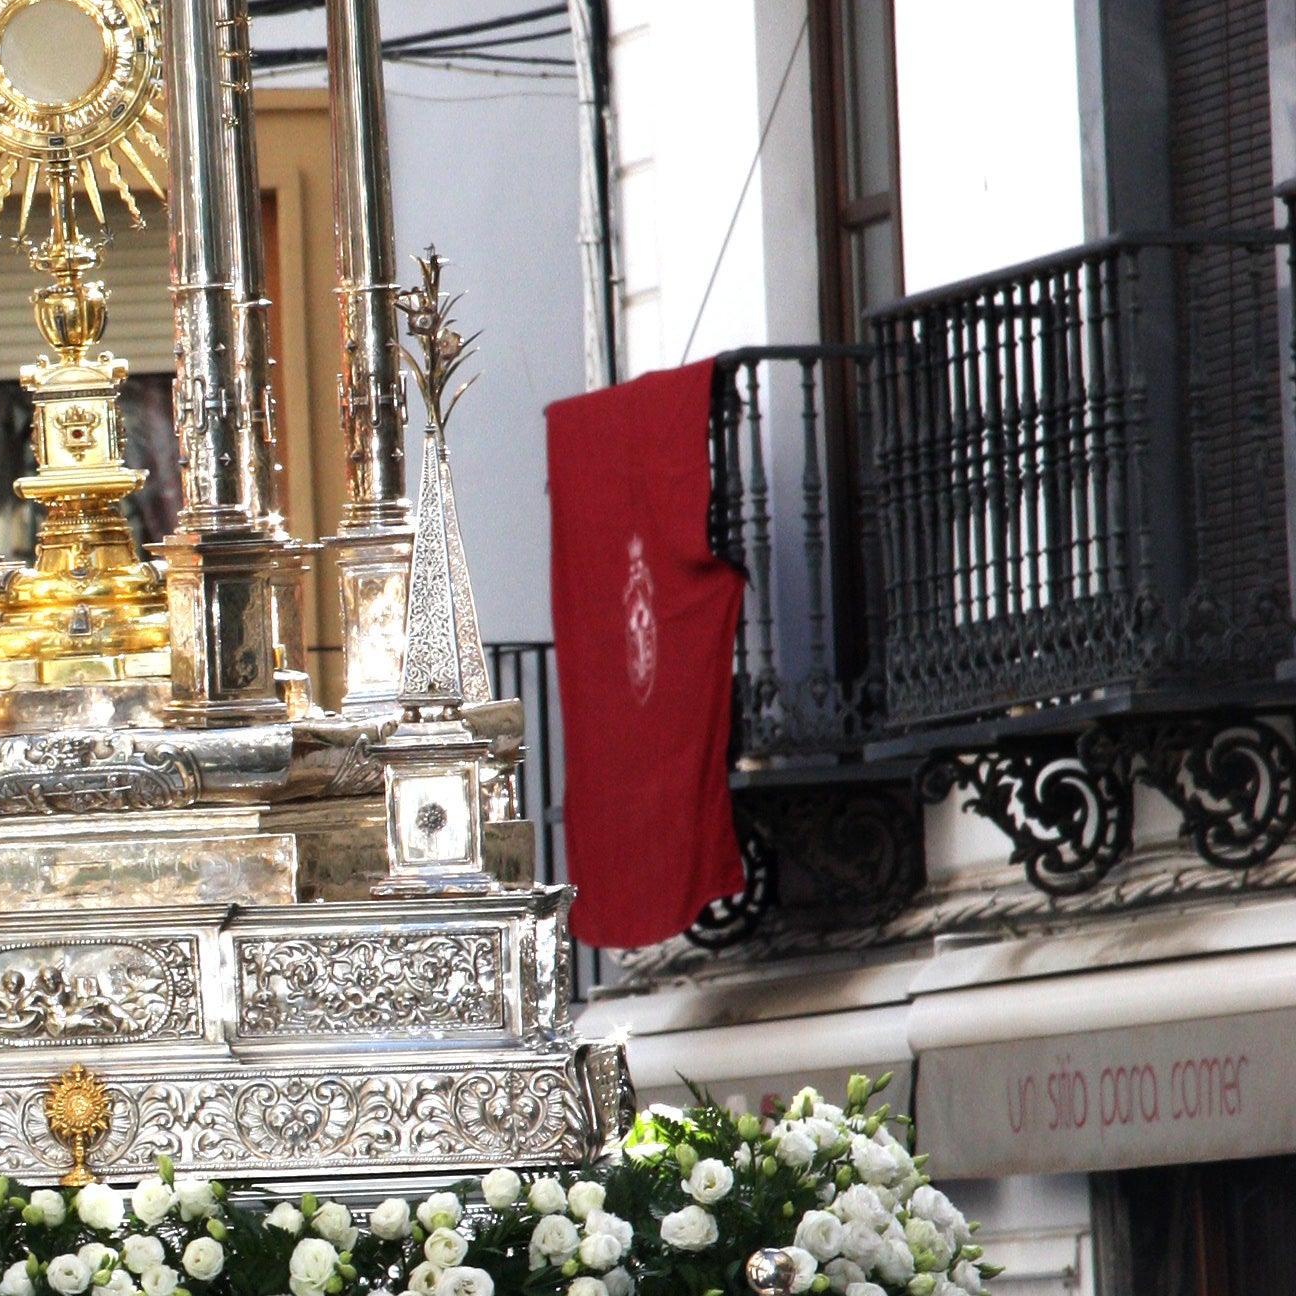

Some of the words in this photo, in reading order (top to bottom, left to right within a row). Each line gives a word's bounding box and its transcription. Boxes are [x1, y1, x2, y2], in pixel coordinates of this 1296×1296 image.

[1007, 1076, 1037, 1134] un
[1048, 1054, 1088, 1131] sitio
[1100, 1062, 1160, 1144] para
[1171, 1055, 1249, 1121] comer
